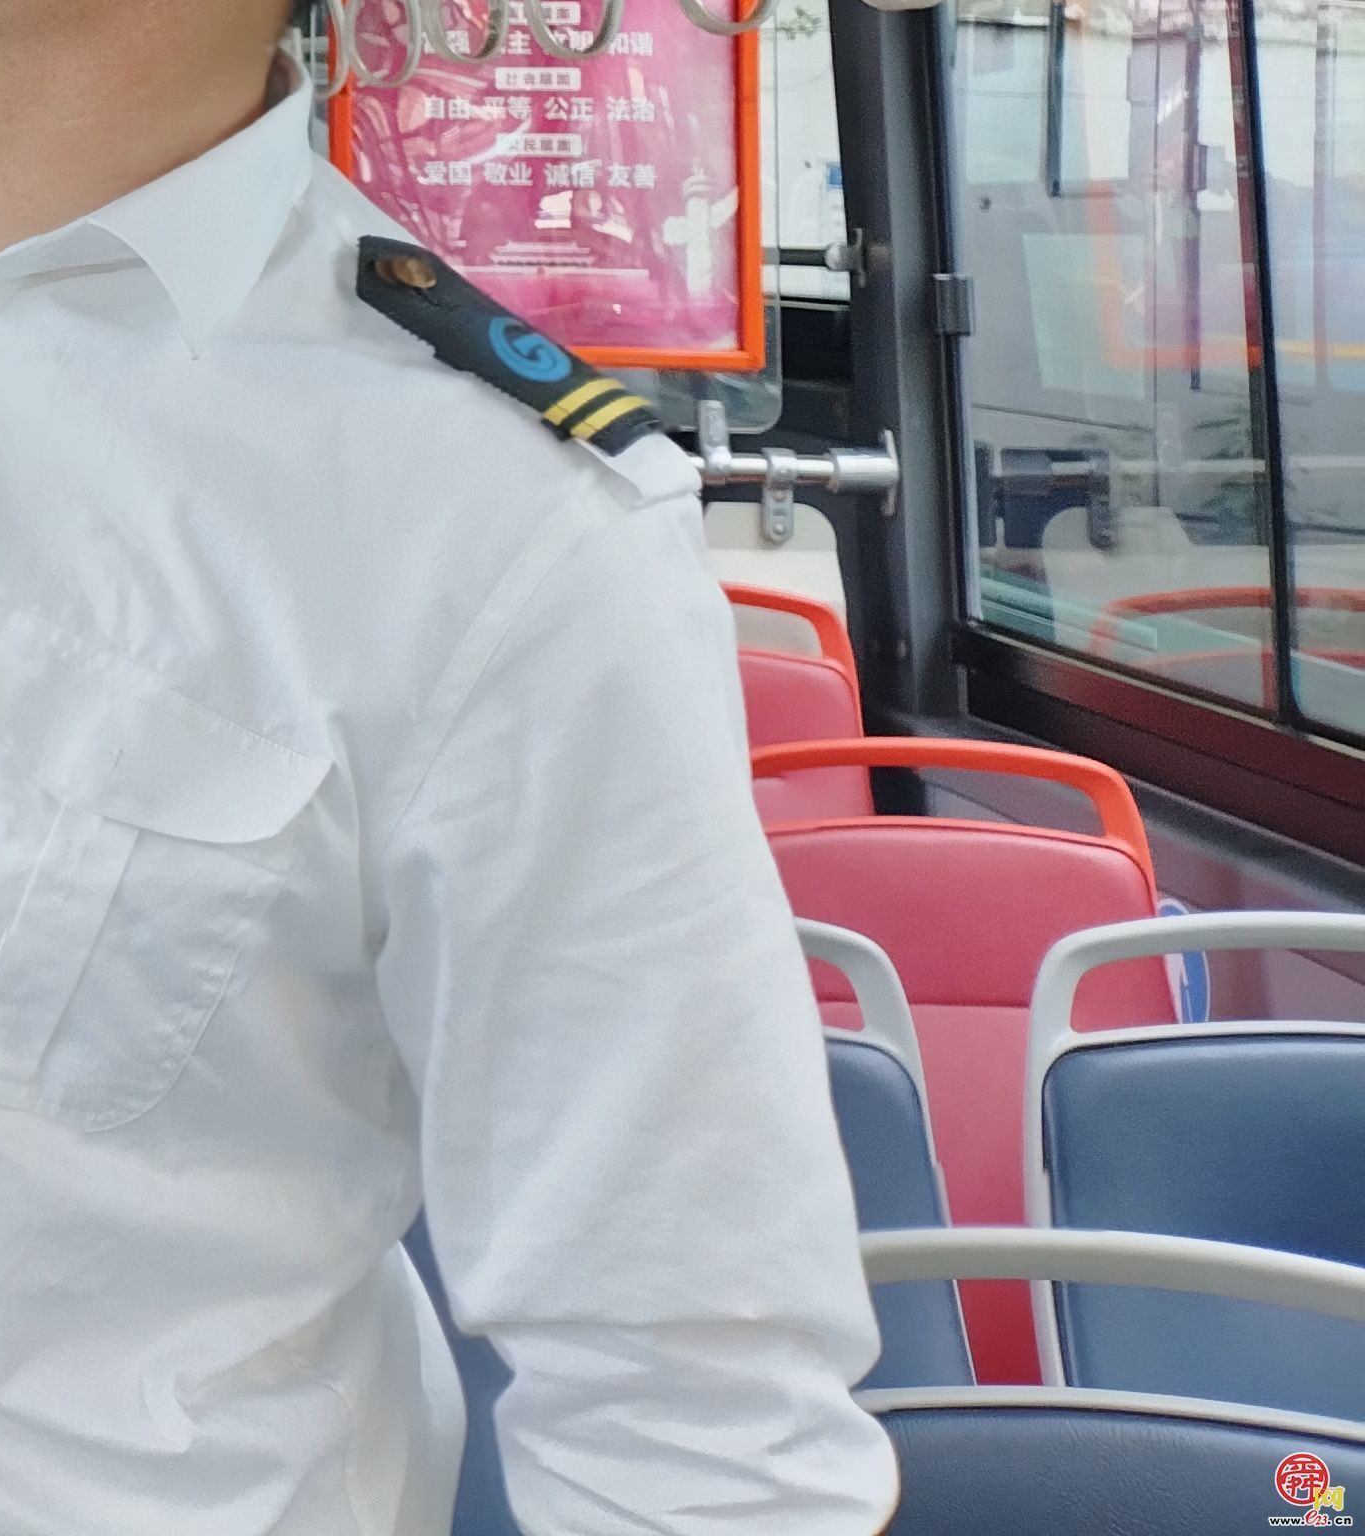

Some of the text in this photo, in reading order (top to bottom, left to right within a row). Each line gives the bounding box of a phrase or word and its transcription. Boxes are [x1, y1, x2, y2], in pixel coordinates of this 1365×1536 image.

[424, 95, 656, 122] 自由 平等 公正 法治
[422, 160, 658, 188] 爱国 敬业 诚信 友善
